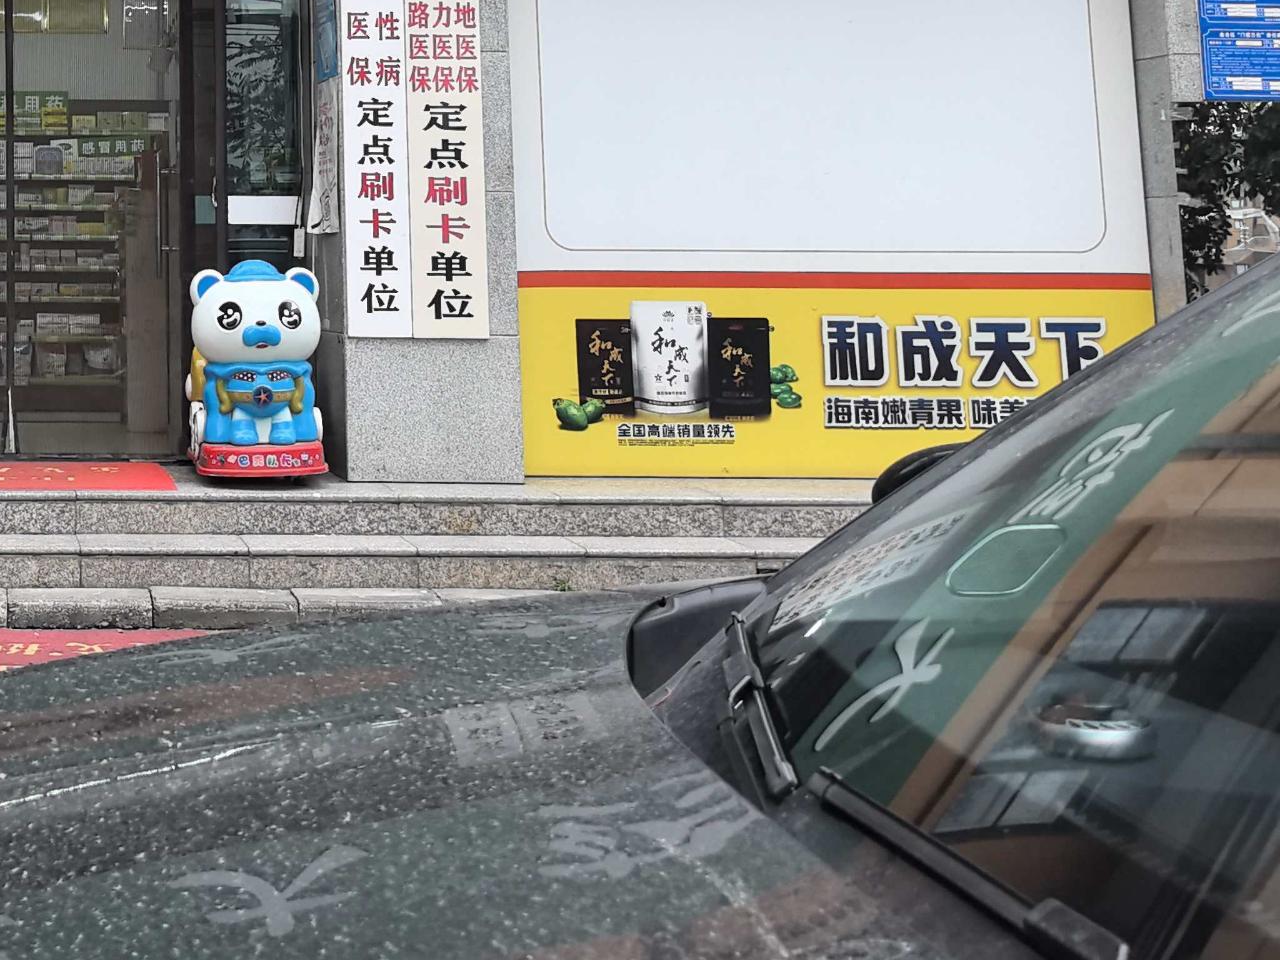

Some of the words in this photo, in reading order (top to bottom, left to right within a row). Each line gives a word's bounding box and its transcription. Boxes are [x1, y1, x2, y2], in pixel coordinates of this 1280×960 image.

[357, 98, 400, 314] 定点刷卡单位
[423, 102, 474, 320] 定点刷卡单位
[651, 326, 689, 387] 和成天下
[822, 315, 1107, 388] 和成天下
[617, 423, 735, 438] 全国高端销量领先
[824, 397, 965, 428] 海南嫩青果
